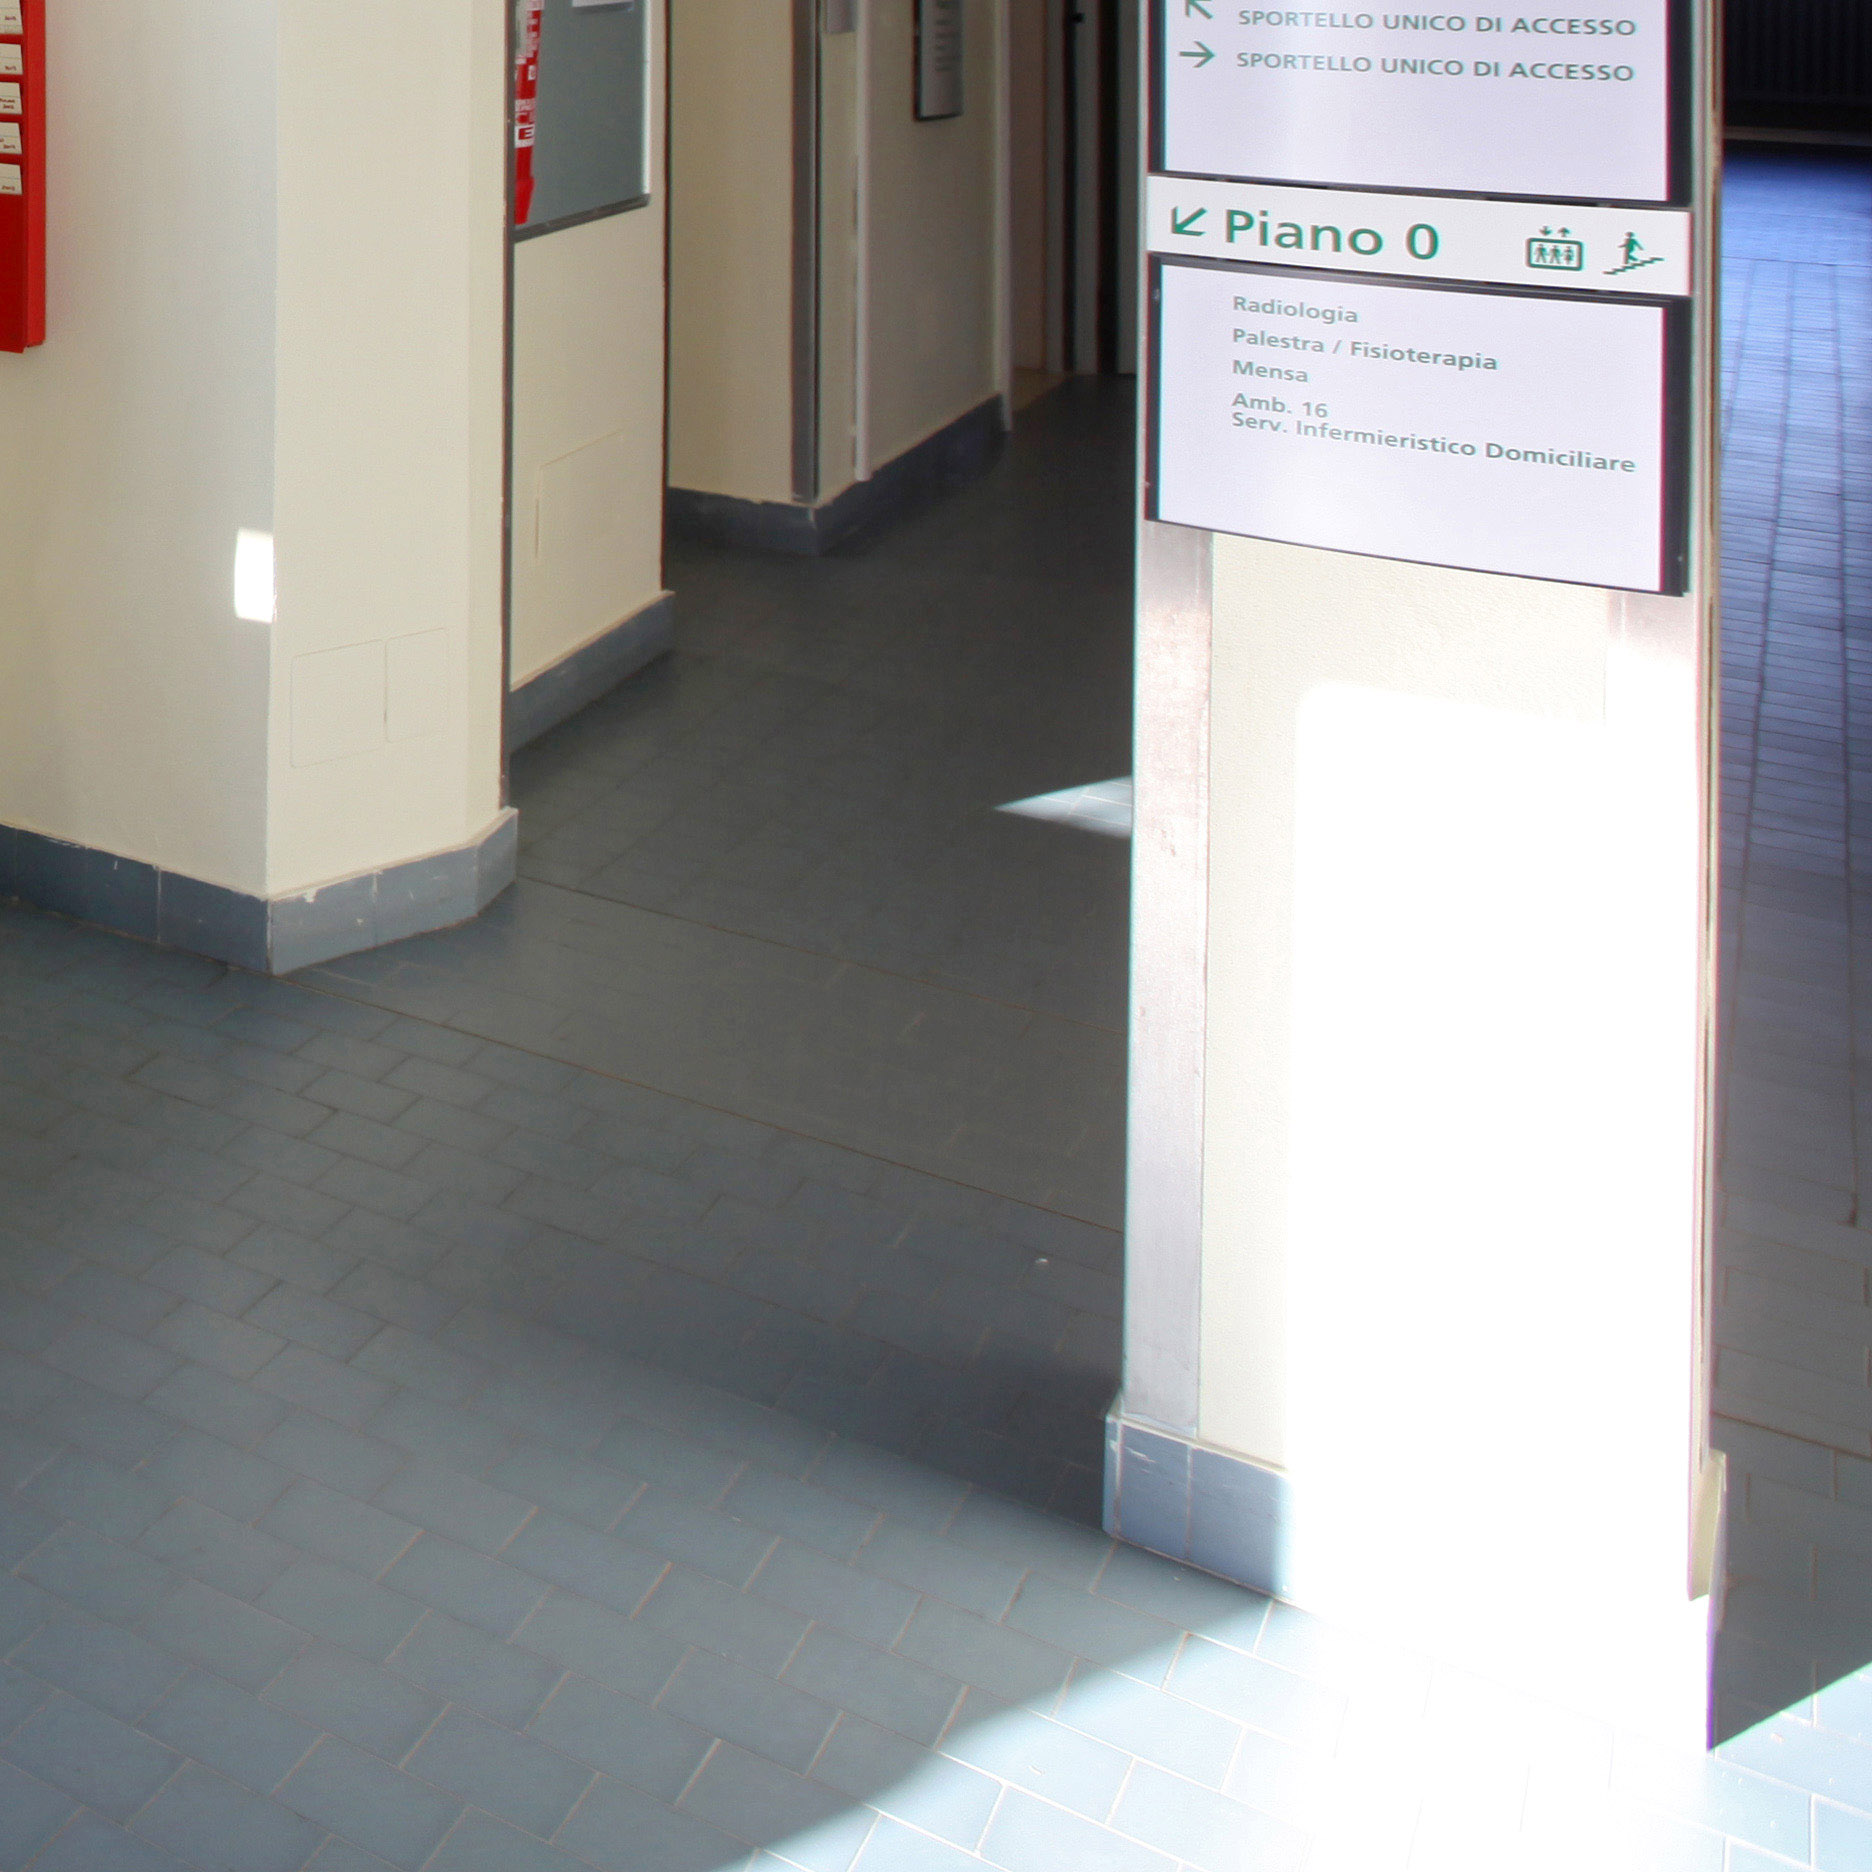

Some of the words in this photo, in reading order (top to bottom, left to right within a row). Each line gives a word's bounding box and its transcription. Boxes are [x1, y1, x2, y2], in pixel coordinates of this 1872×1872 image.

[1238, 8, 1373, 30] SPORTELLO
[1384, 12, 1465, 32] UNICO
[1475, 14, 1502, 33] DI
[1511, 16, 1637, 37] ACCESSO
[1236, 50, 1372, 74] SPORTELLO
[1381, 57, 1464, 77] UNICO
[1472, 59, 1500, 78] DI
[1508, 60, 1635, 82] ACCESSO
[1224, 209, 1384, 256] Piano
[1405, 222, 1440, 261] 0
[1233, 295, 1358, 325] Radiologia
[1233, 328, 1324, 354] Palestra
[1350, 340, 1497, 371] Fisioterapia
[1232, 359, 1308, 384] Mensa
[1232, 392, 1294, 415] Amb.
[1301, 400, 1328, 419] 16
[1232, 411, 1287, 435] Serv.
[1296, 420, 1476, 458] Infermieristico
[1485, 442, 1636, 473] Domiciliare
